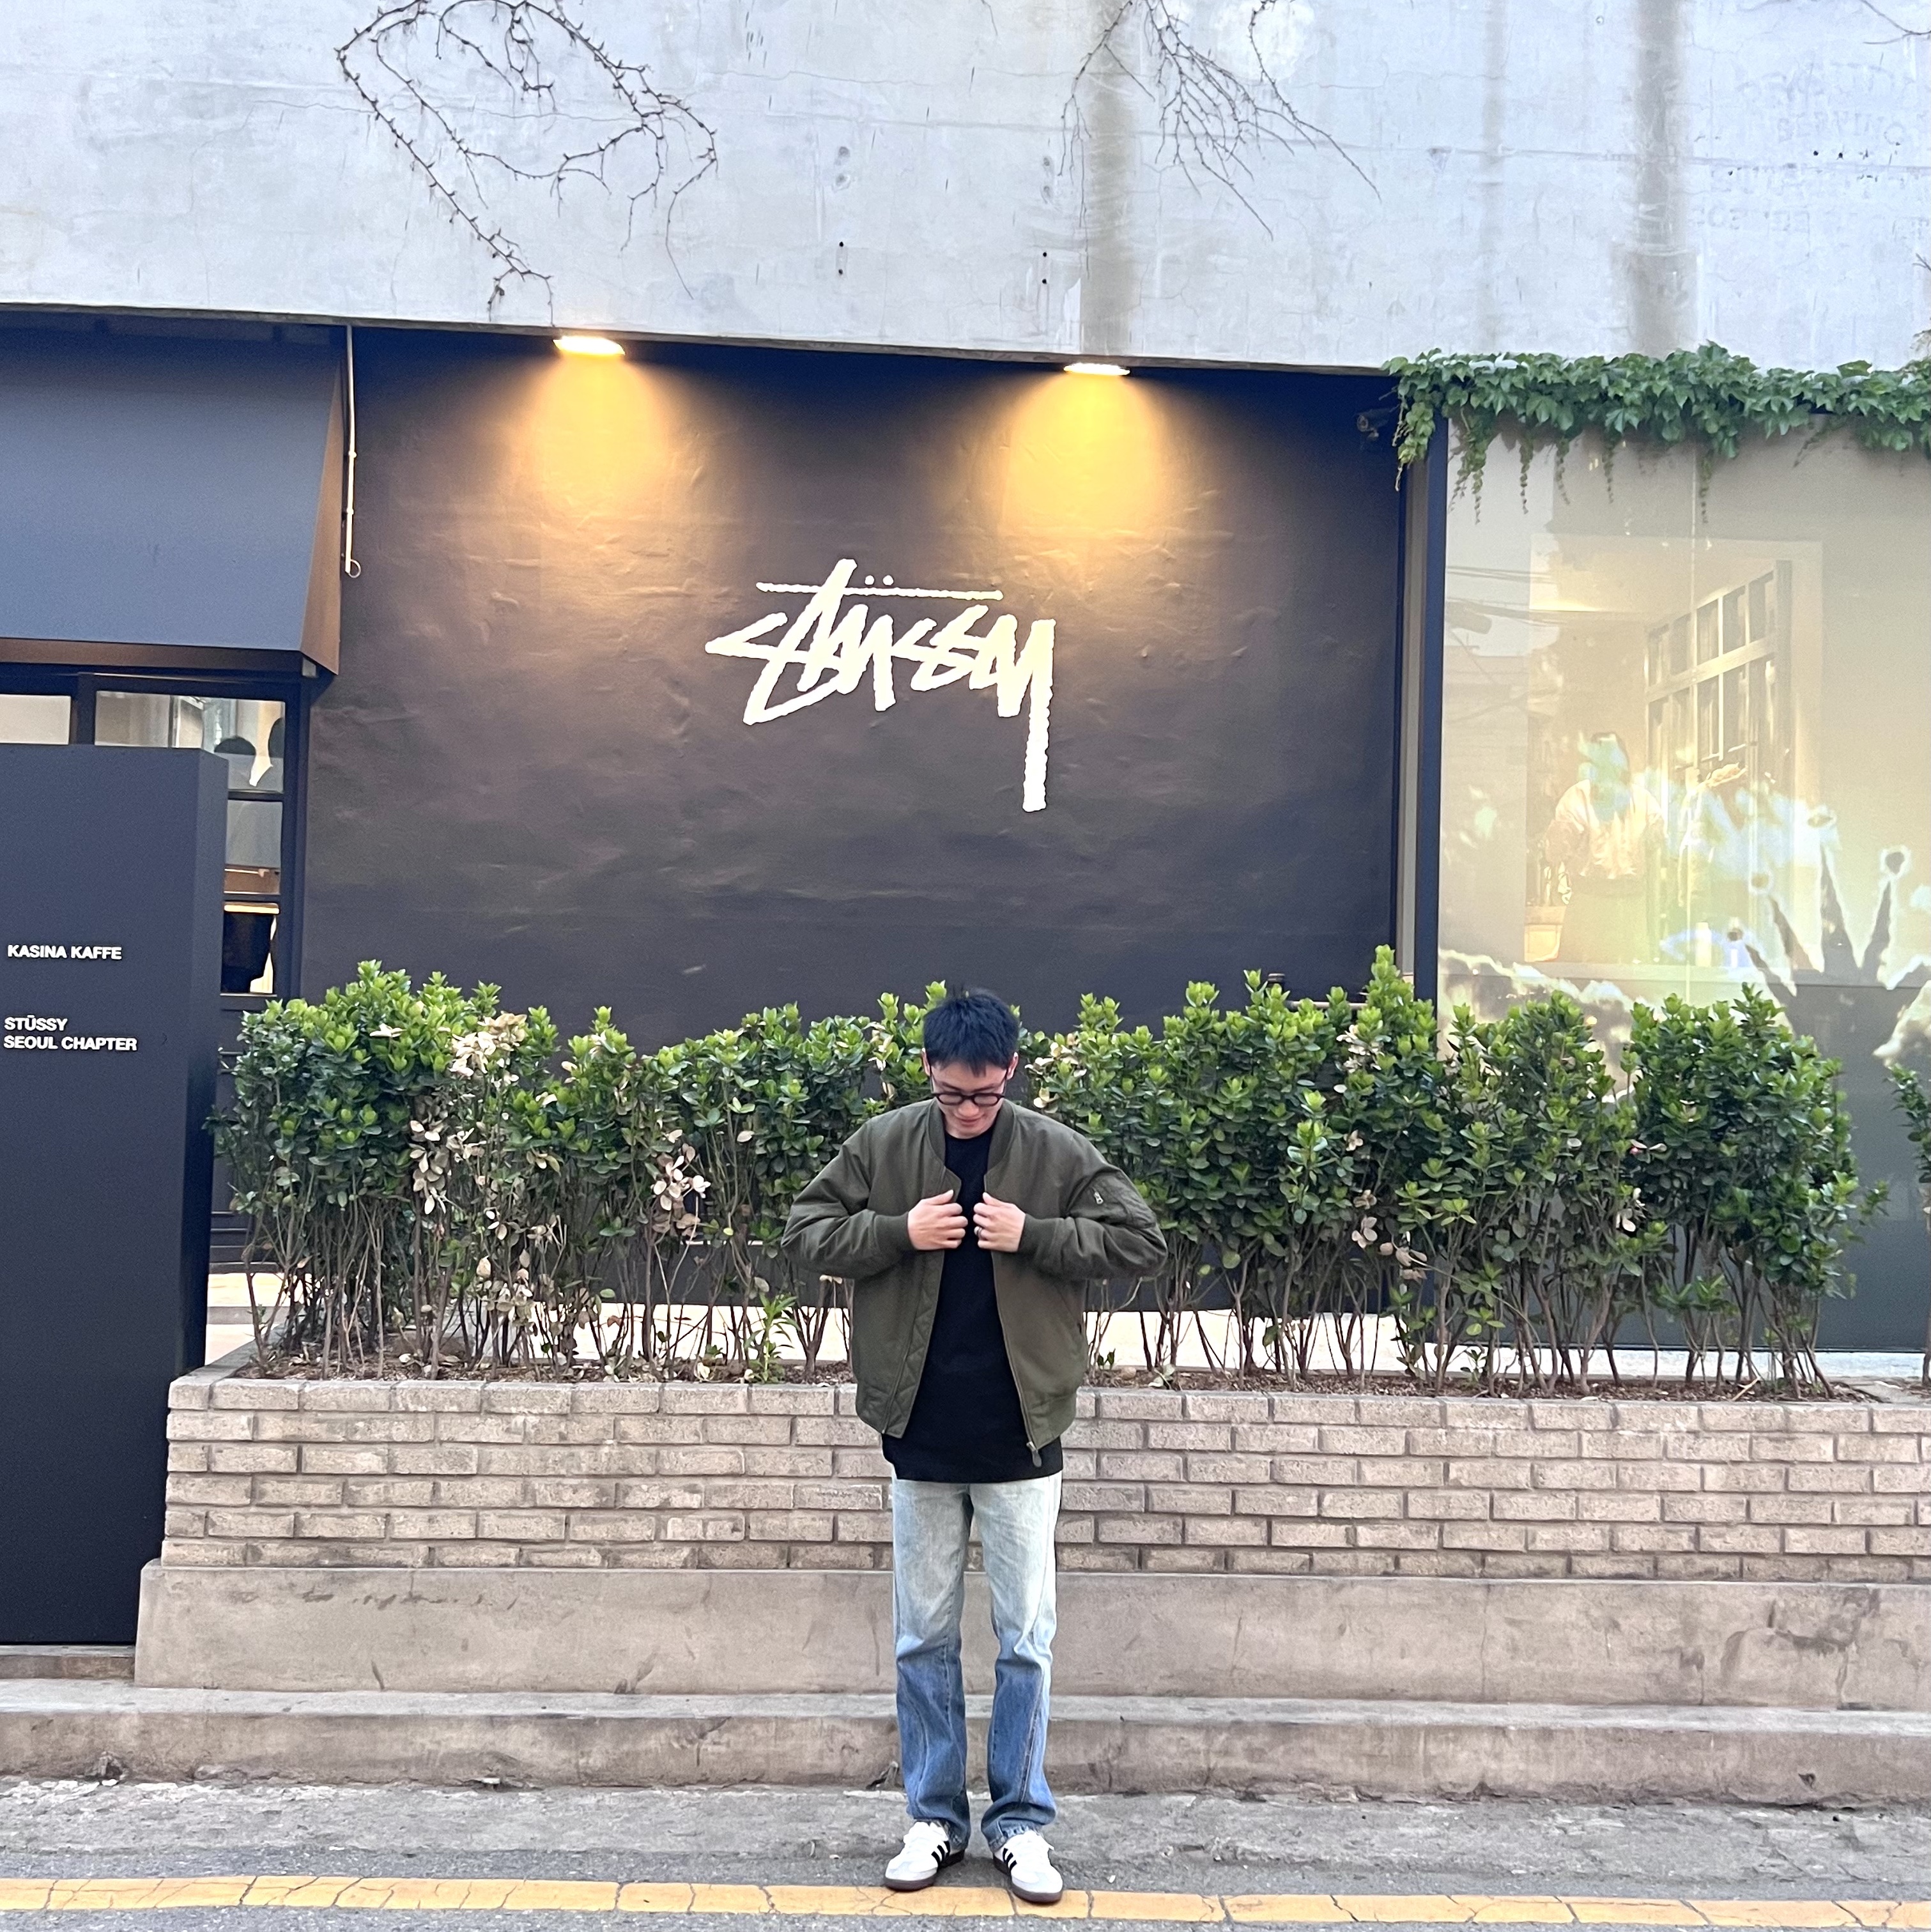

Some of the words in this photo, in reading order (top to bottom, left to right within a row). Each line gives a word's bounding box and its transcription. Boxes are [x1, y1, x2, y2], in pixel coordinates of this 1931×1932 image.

[7, 944, 67, 958] KASINA
[70, 946, 122, 960] KAFFE
[3, 1035, 58, 1050] SEOUL
[61, 1036, 137, 1051] CHAPTER
